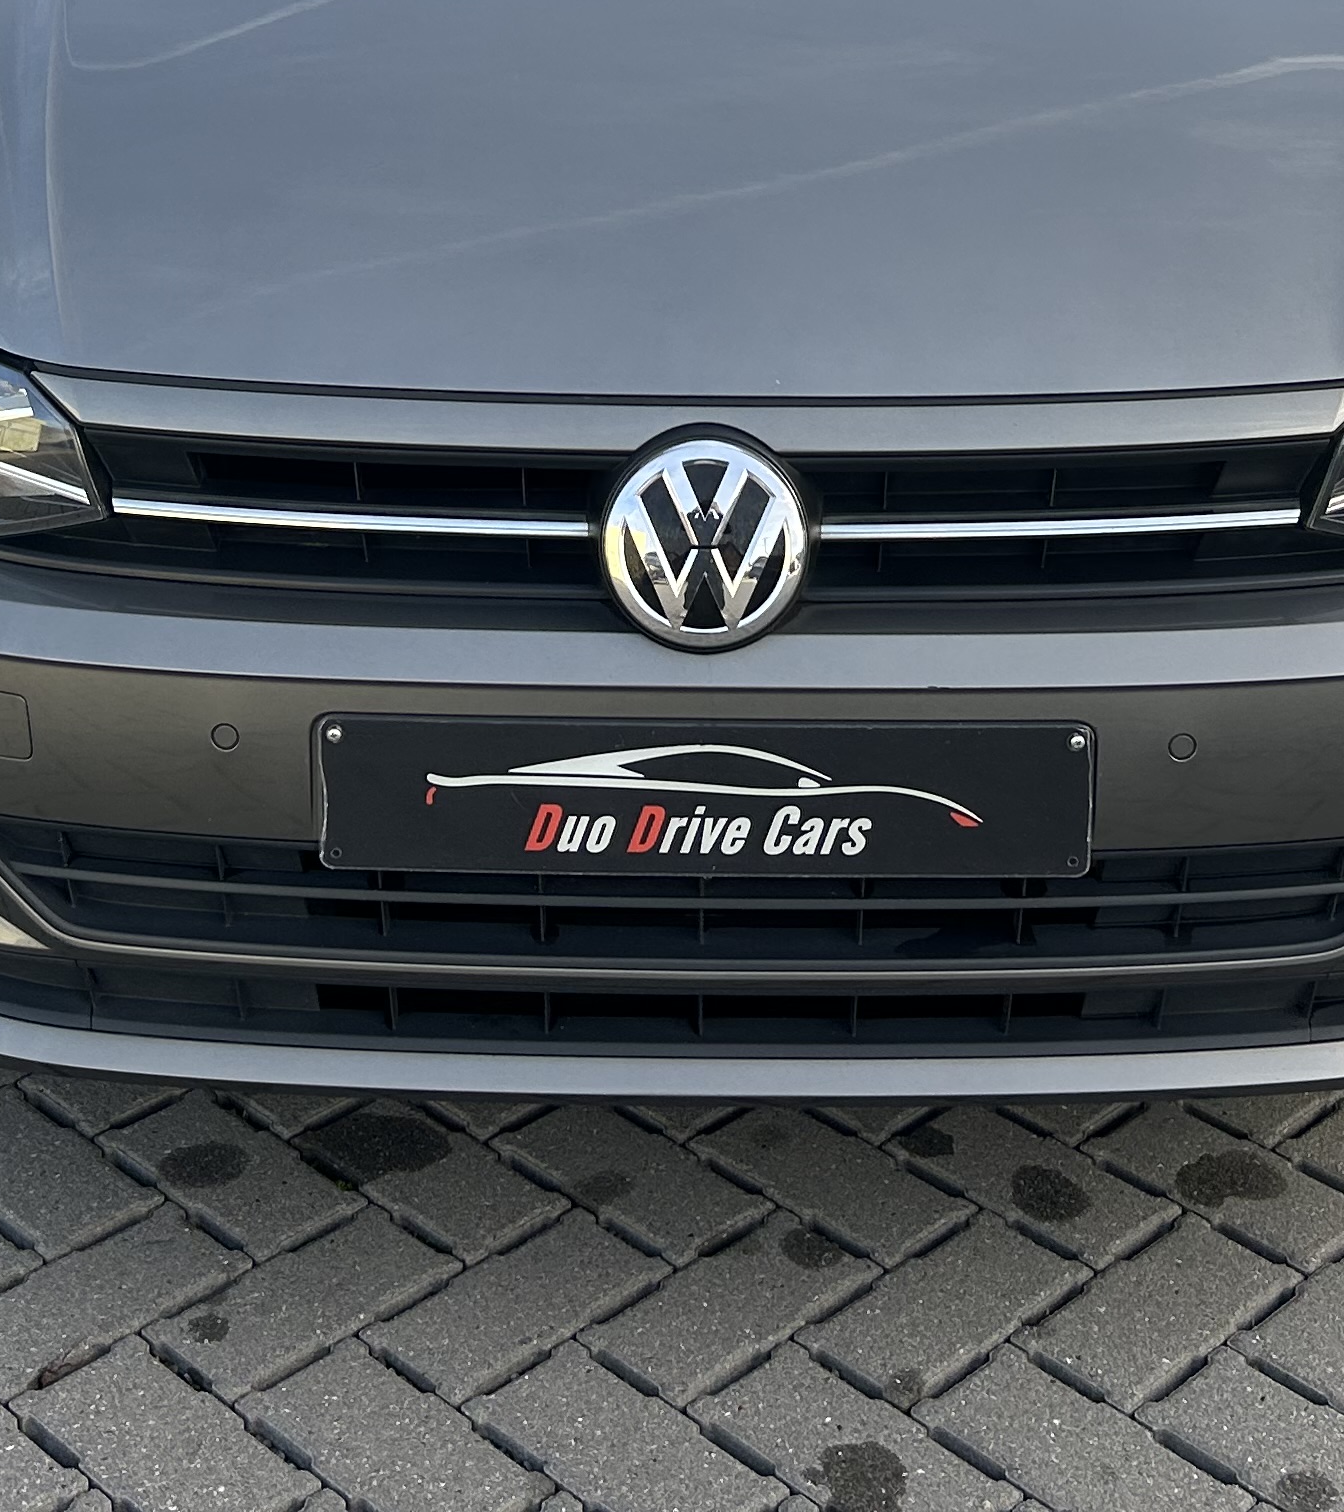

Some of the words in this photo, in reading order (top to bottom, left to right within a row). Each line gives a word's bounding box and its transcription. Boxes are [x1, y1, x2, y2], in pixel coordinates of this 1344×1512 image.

[524, 803, 616, 854] Duo
[626, 805, 752, 855] Drive
[763, 805, 872, 856] Cars
